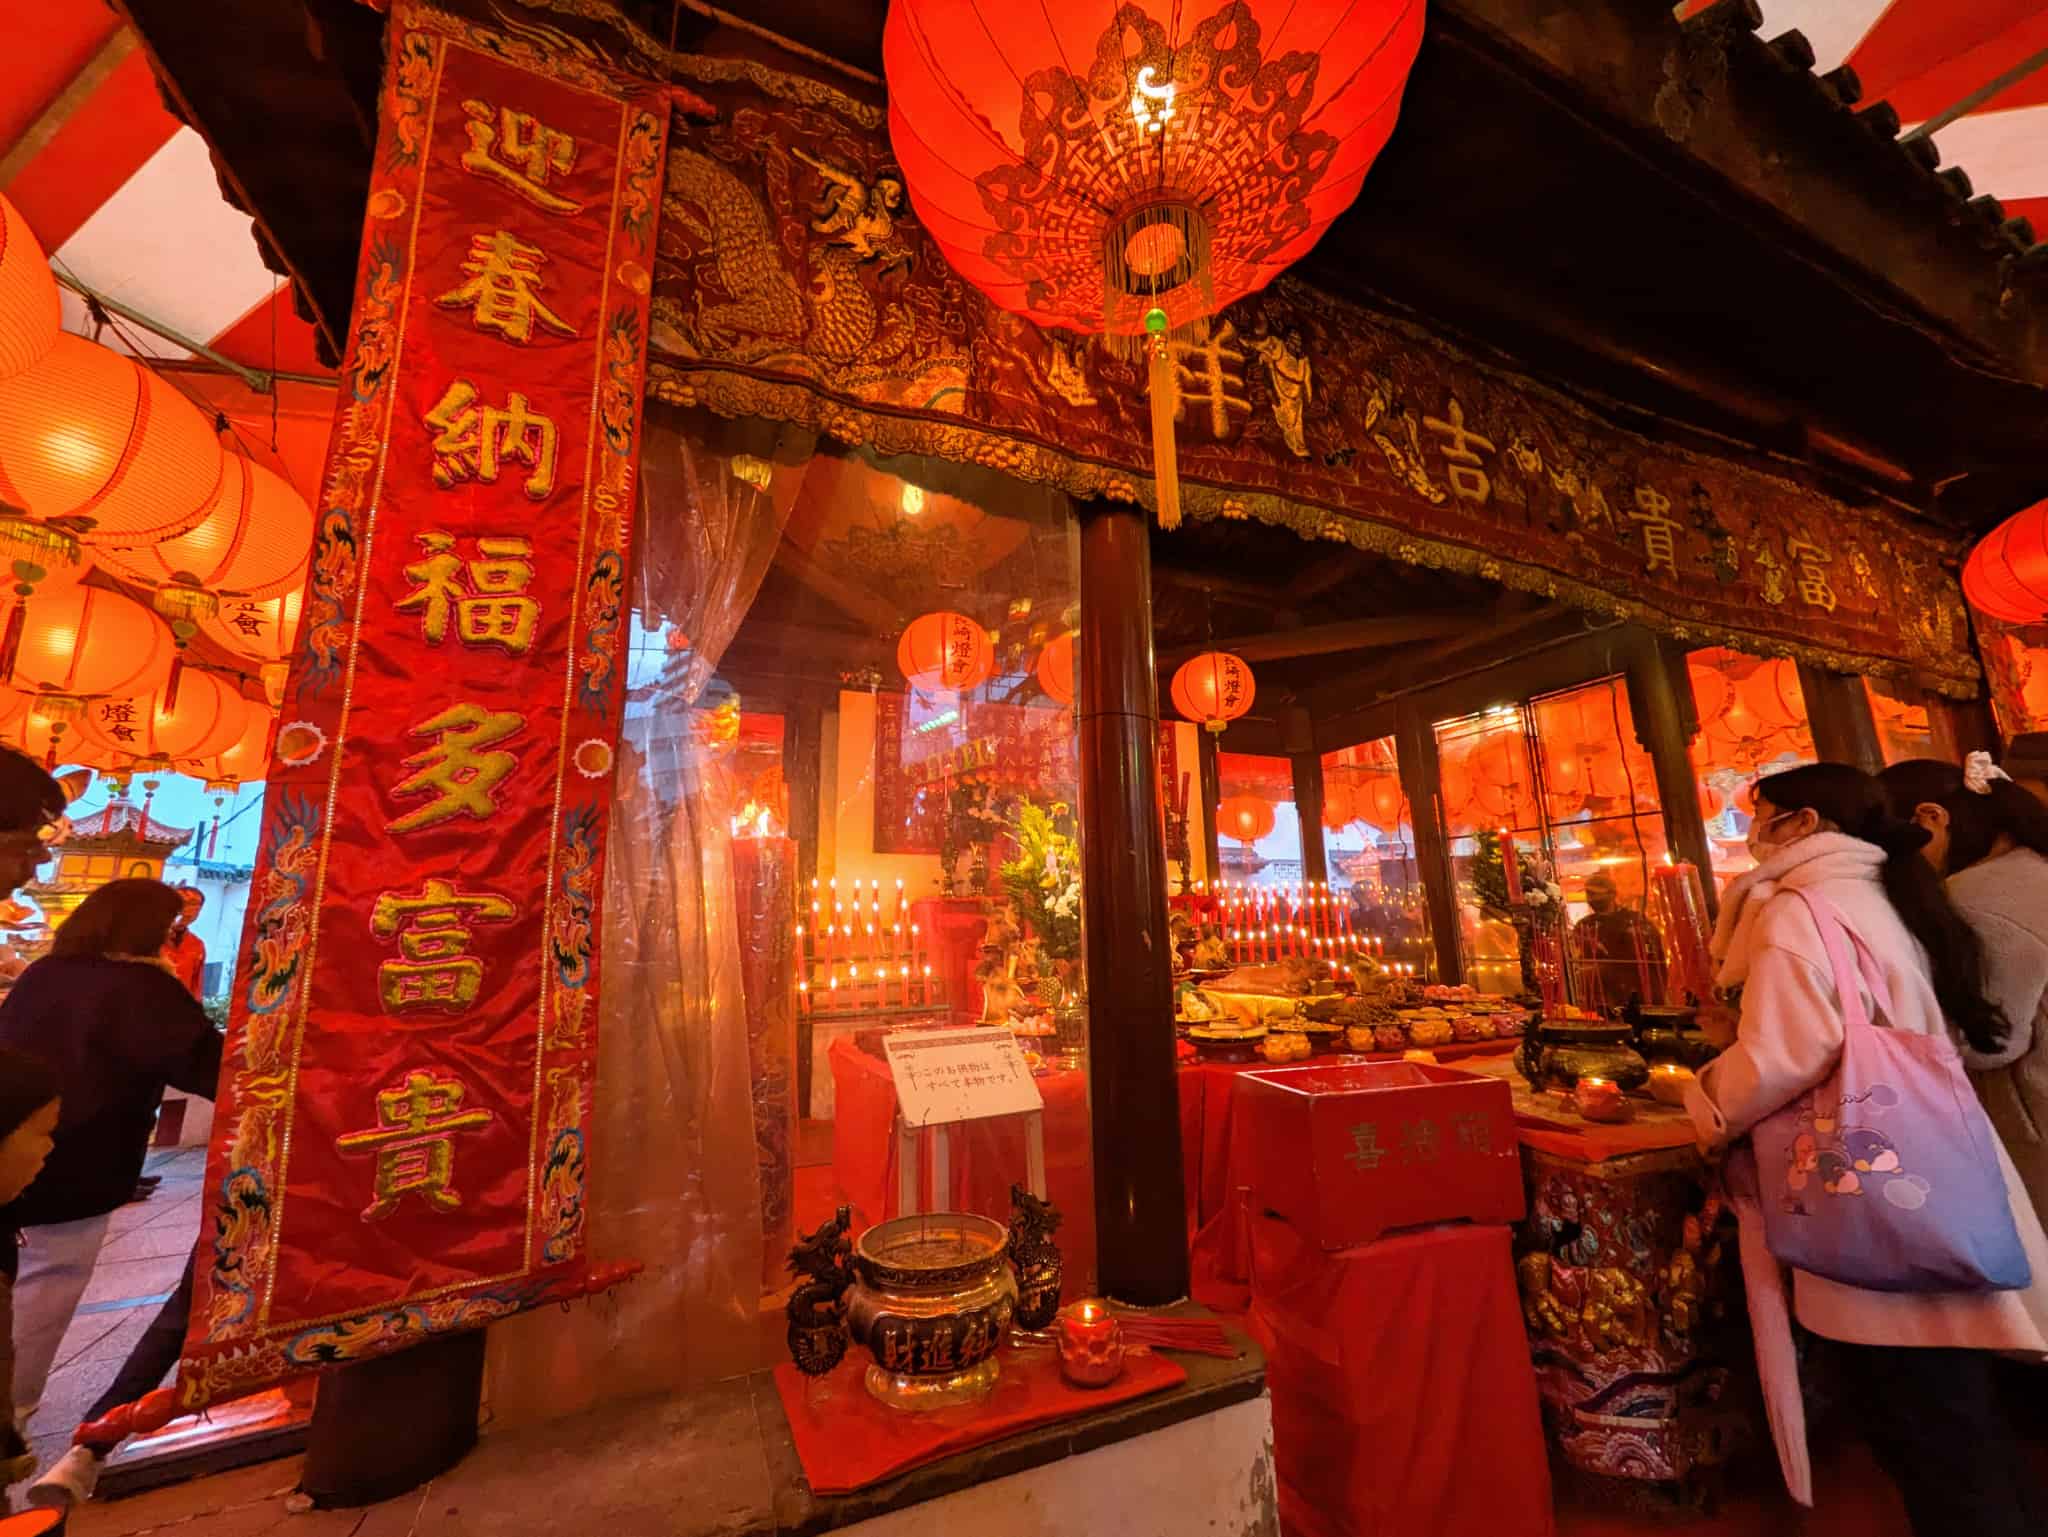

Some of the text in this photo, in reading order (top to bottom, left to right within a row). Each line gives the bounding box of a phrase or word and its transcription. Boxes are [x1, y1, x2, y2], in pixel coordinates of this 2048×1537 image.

[336, 98, 584, 1222] 迎春納福多富貴
